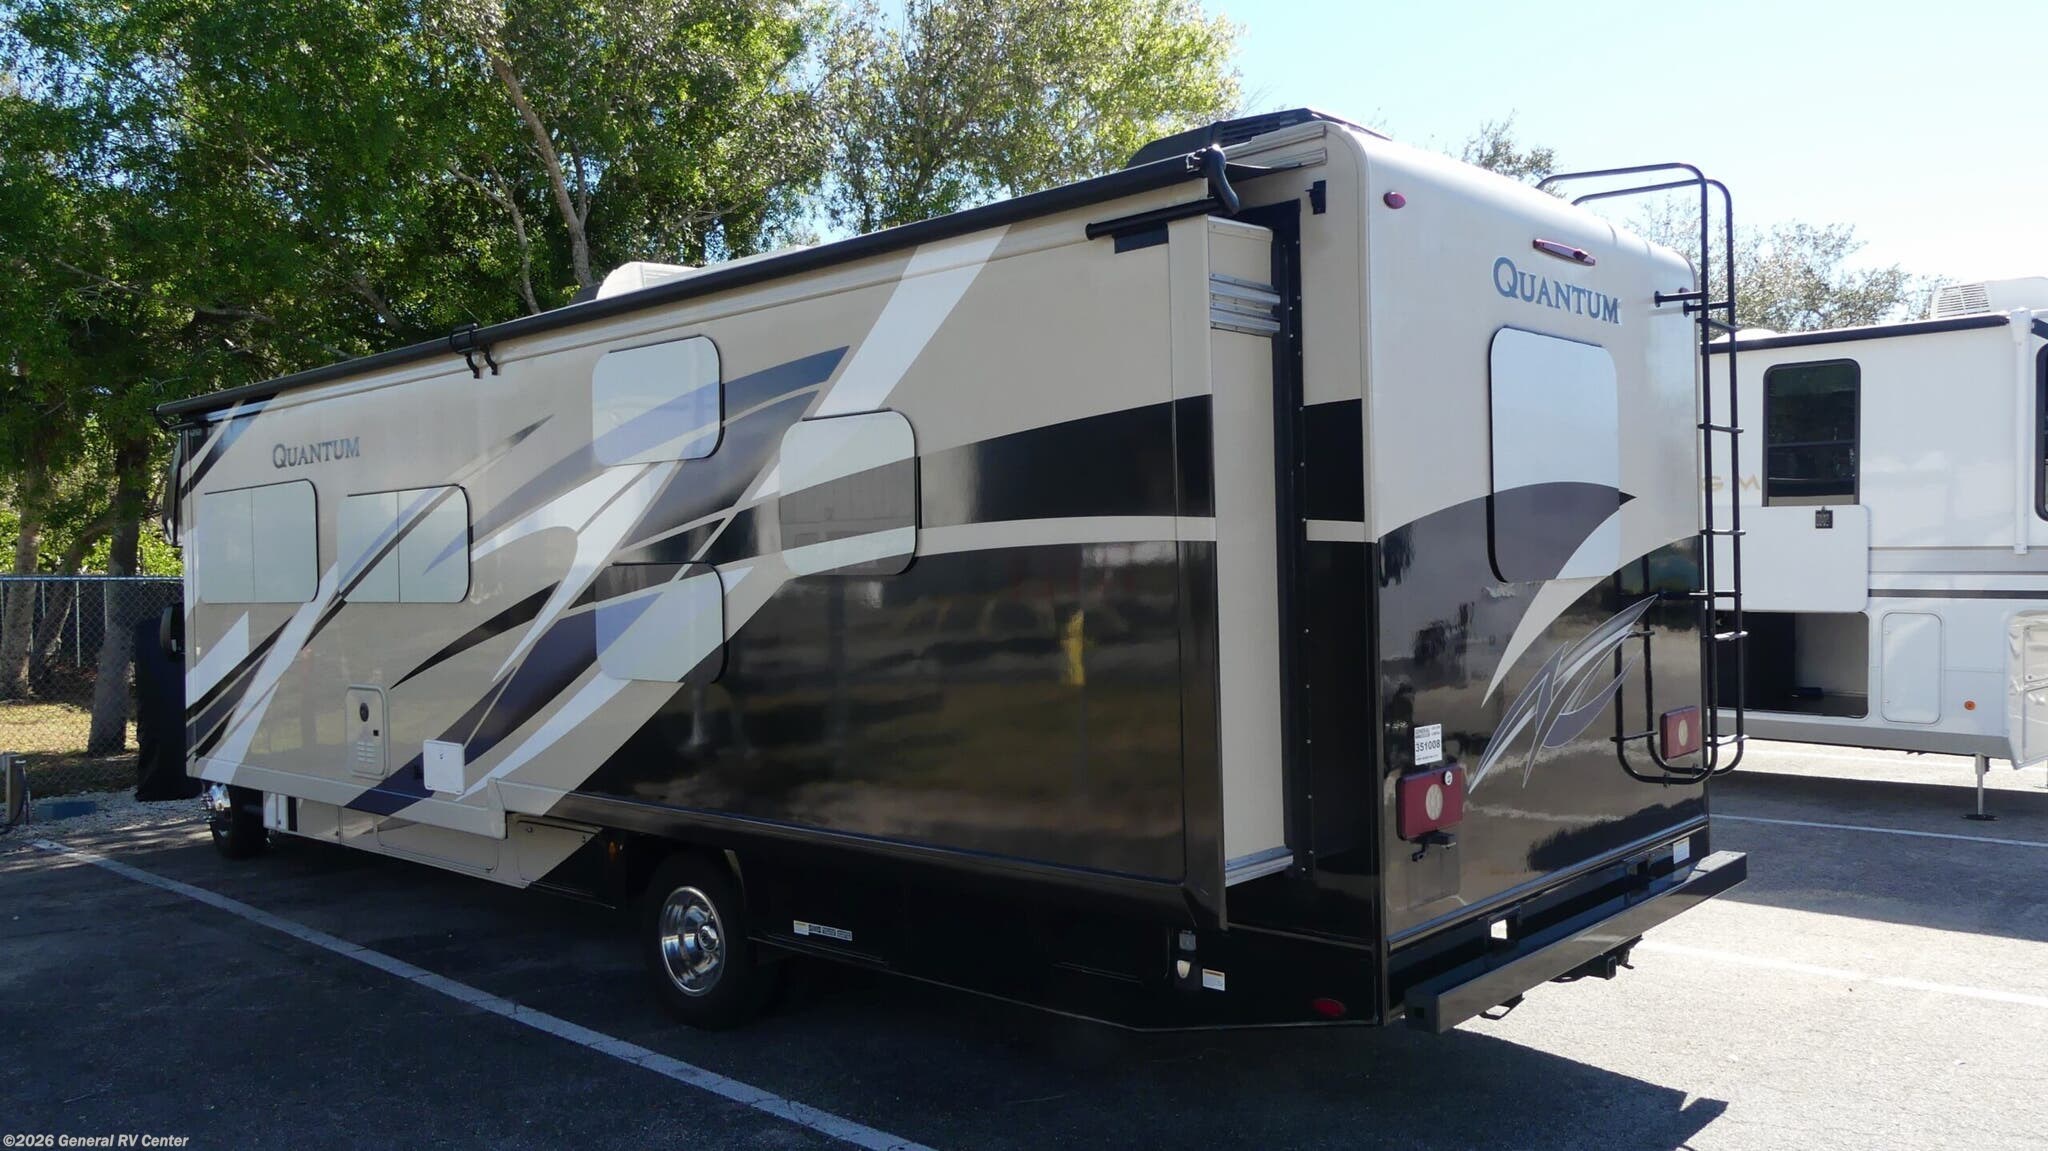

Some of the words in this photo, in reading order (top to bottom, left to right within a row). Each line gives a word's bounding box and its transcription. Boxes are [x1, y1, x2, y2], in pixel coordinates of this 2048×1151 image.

[1493, 256, 1619, 325] QUANTUM
[272, 436, 361, 469] QUANTUM
[1415, 739, 1441, 752] 351008
